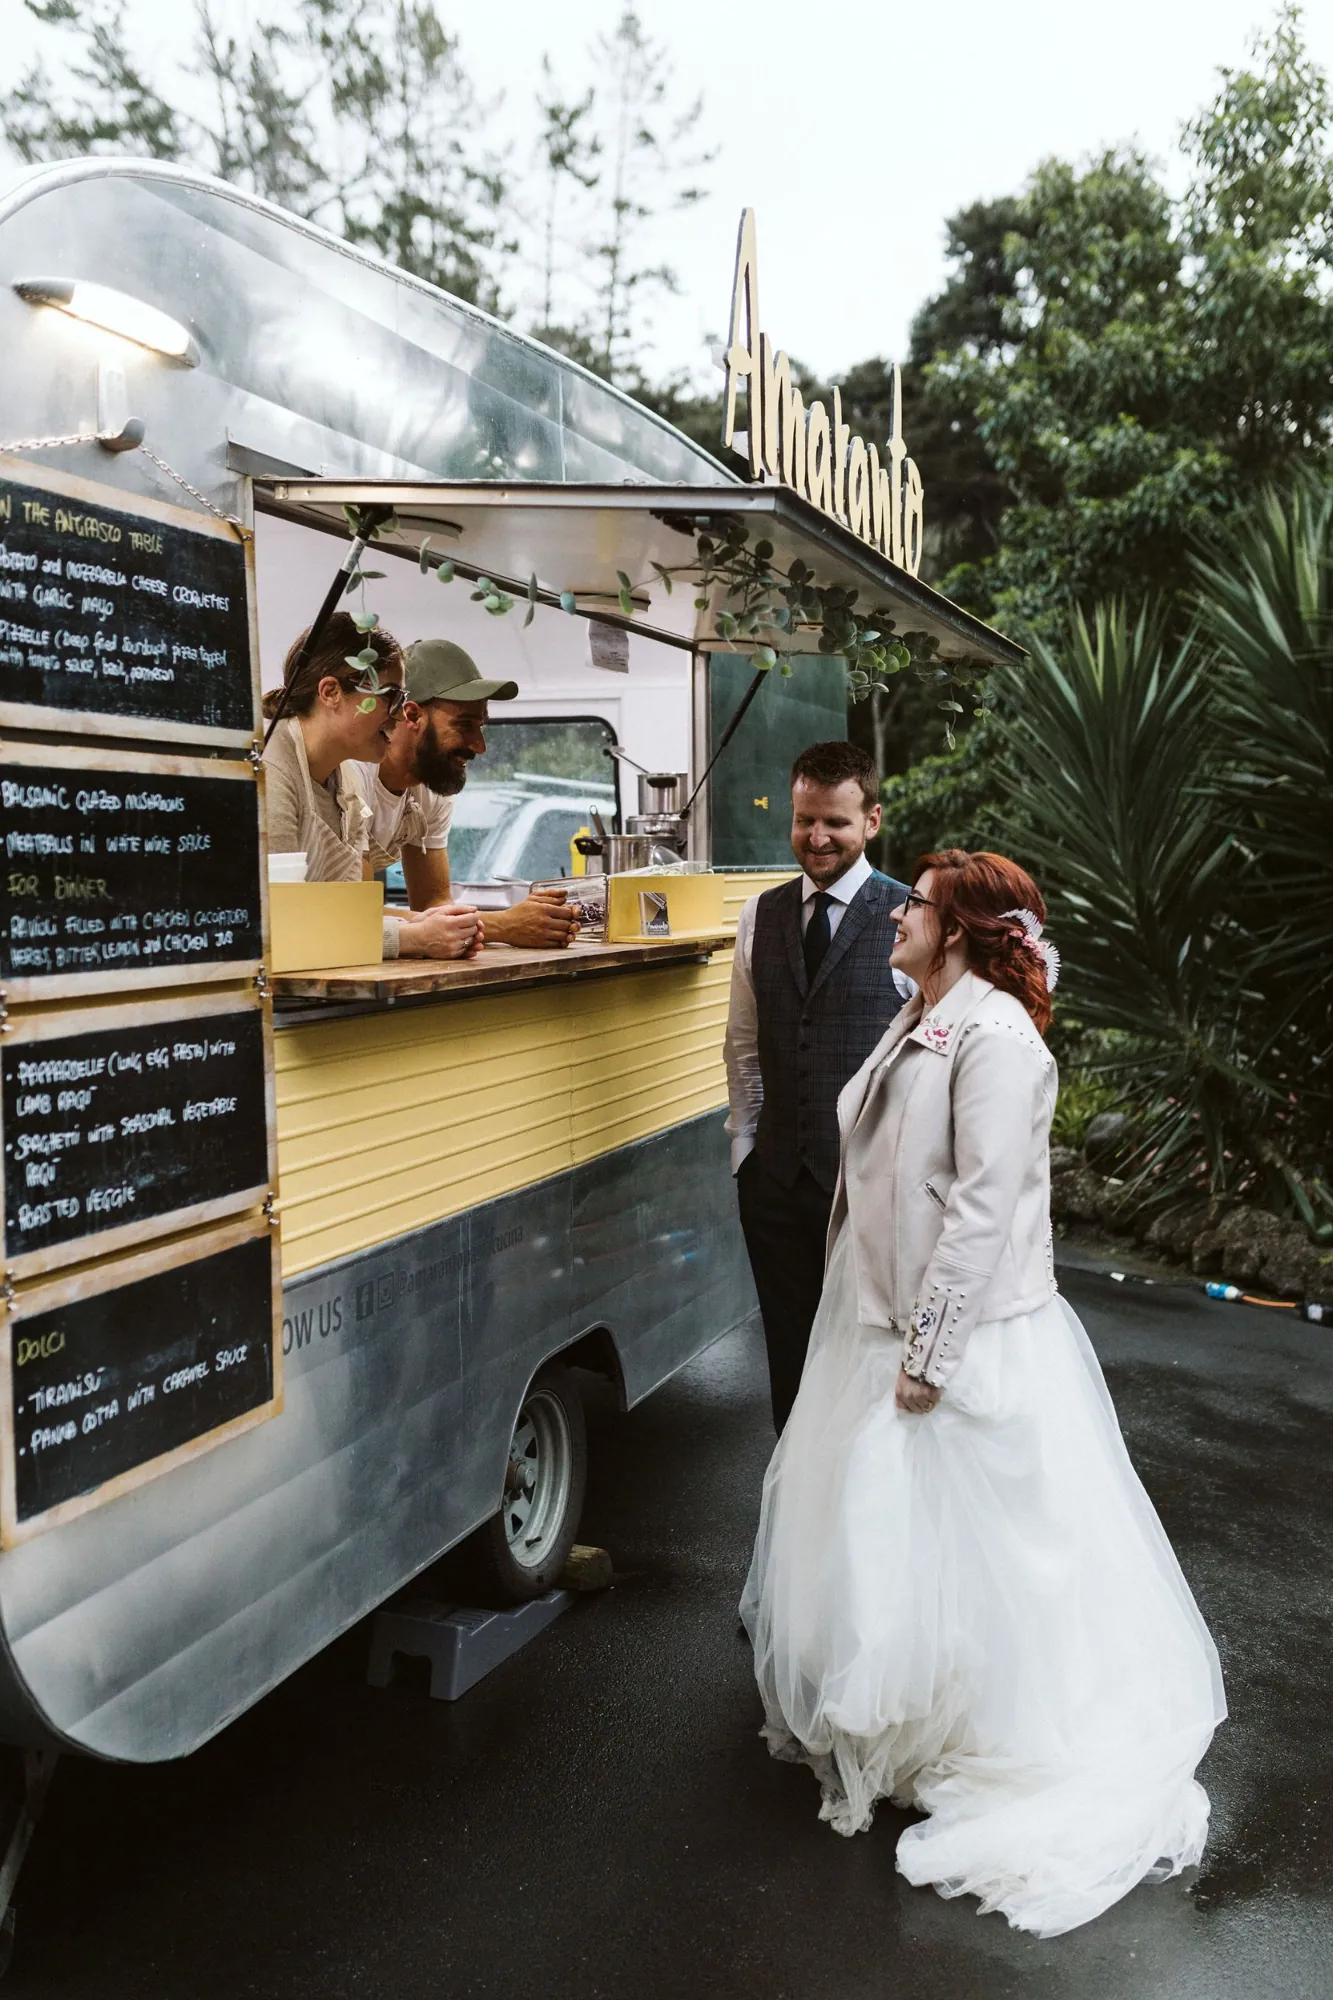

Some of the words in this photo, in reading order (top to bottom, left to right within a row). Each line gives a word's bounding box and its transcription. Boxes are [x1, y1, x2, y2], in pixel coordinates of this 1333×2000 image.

[22, 501, 51, 527] THE
[128, 531, 163, 555] TABLE
[42, 557, 62, 577] and
[66, 560, 127, 587] MOZZARELLA
[132, 575, 168, 597] CHEESE
[172, 585, 230, 612] CROQUETTES
[27, 648, 61, 670] tomato
[130, 667, 175, 684] parmesan
[172, 642, 198, 664] pizza
[199, 645, 227, 671] topped
[76, 789, 122, 815] GLAZED
[125, 791, 185, 812] MUSHROOMS
[6, 830, 74, 859] MEATBALLS
[177, 833, 211, 853] SAUCE
[7, 873, 40, 897] FOR
[146, 1047, 169, 1069] EGG
[16, 1093, 52, 1117] LAMB
[120, 1107, 176, 1136] SEASONAL
[183, 1097, 238, 1122] VEGETABLE
[18, 1197, 80, 1232] ROASTED
[320, 1296, 342, 1338] US
[31, 1420, 77, 1454] PANNA
[82, 1399, 119, 1434] COTTA
[163, 1361, 210, 1393] CARAMEL
